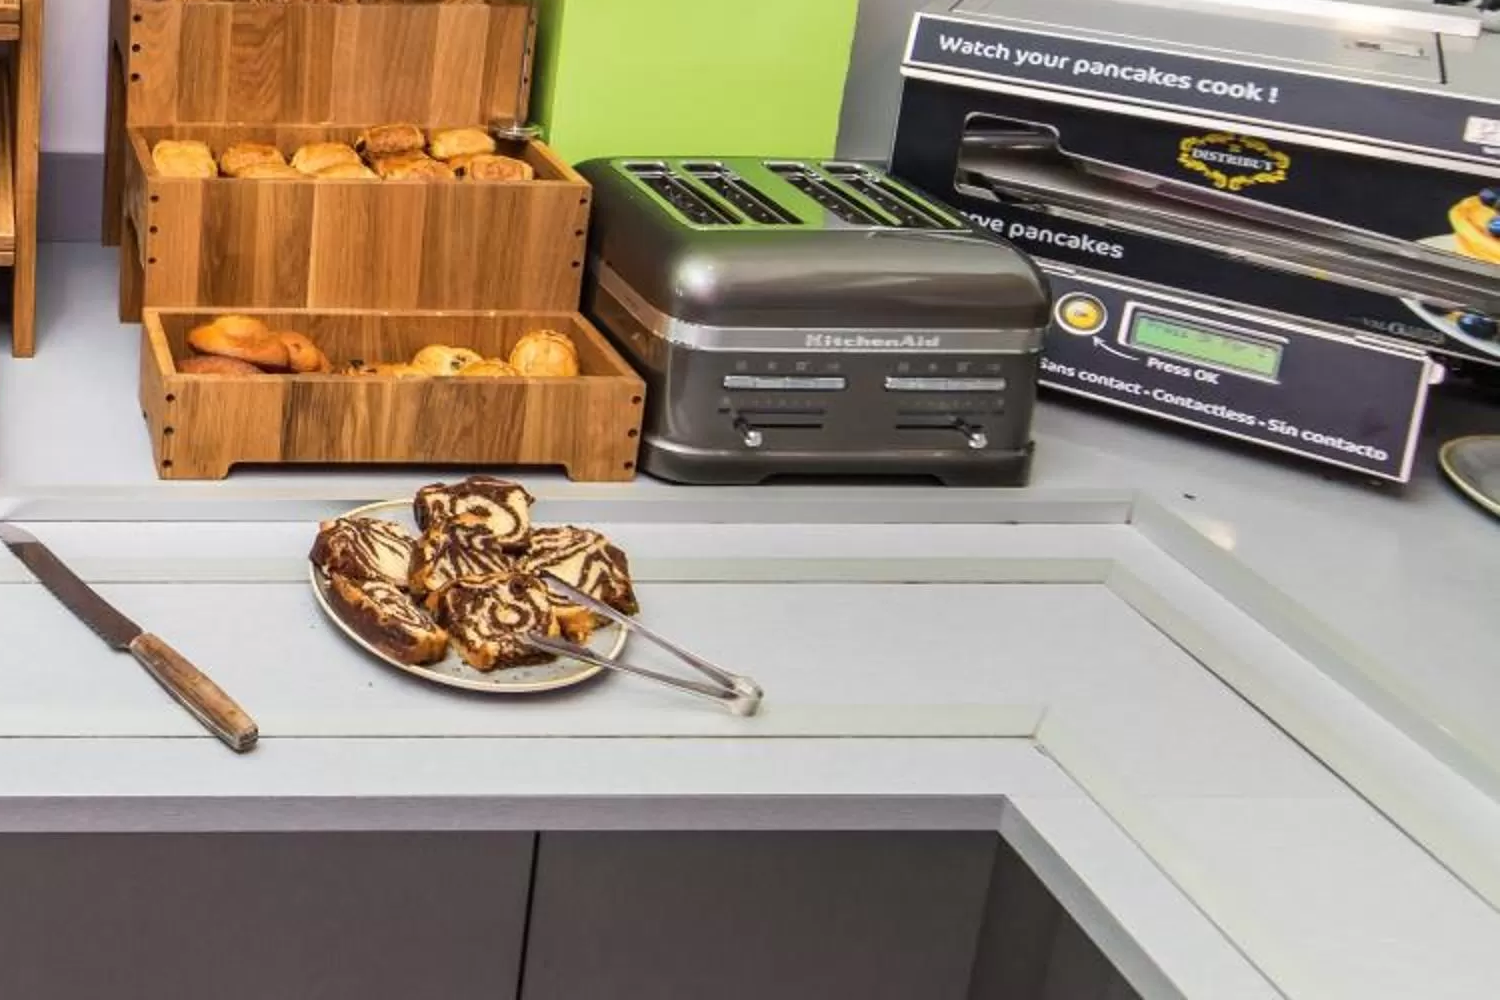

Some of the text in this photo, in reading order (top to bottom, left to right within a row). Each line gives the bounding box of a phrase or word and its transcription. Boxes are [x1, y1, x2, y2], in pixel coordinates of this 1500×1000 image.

[939, 34, 1279, 104] Watch your pancakes cook !
[1008, 223, 1125, 259] pancakes
[805, 334, 940, 347] KitchenAid
[1146, 356, 1221, 385] Press OK
[1039, 356, 1076, 377] Sans
[1077, 370, 1143, 395] contact
[1152, 388, 1256, 426] Contactless
[1267, 418, 1299, 437] Sin
[1300, 429, 1389, 461] contacto
